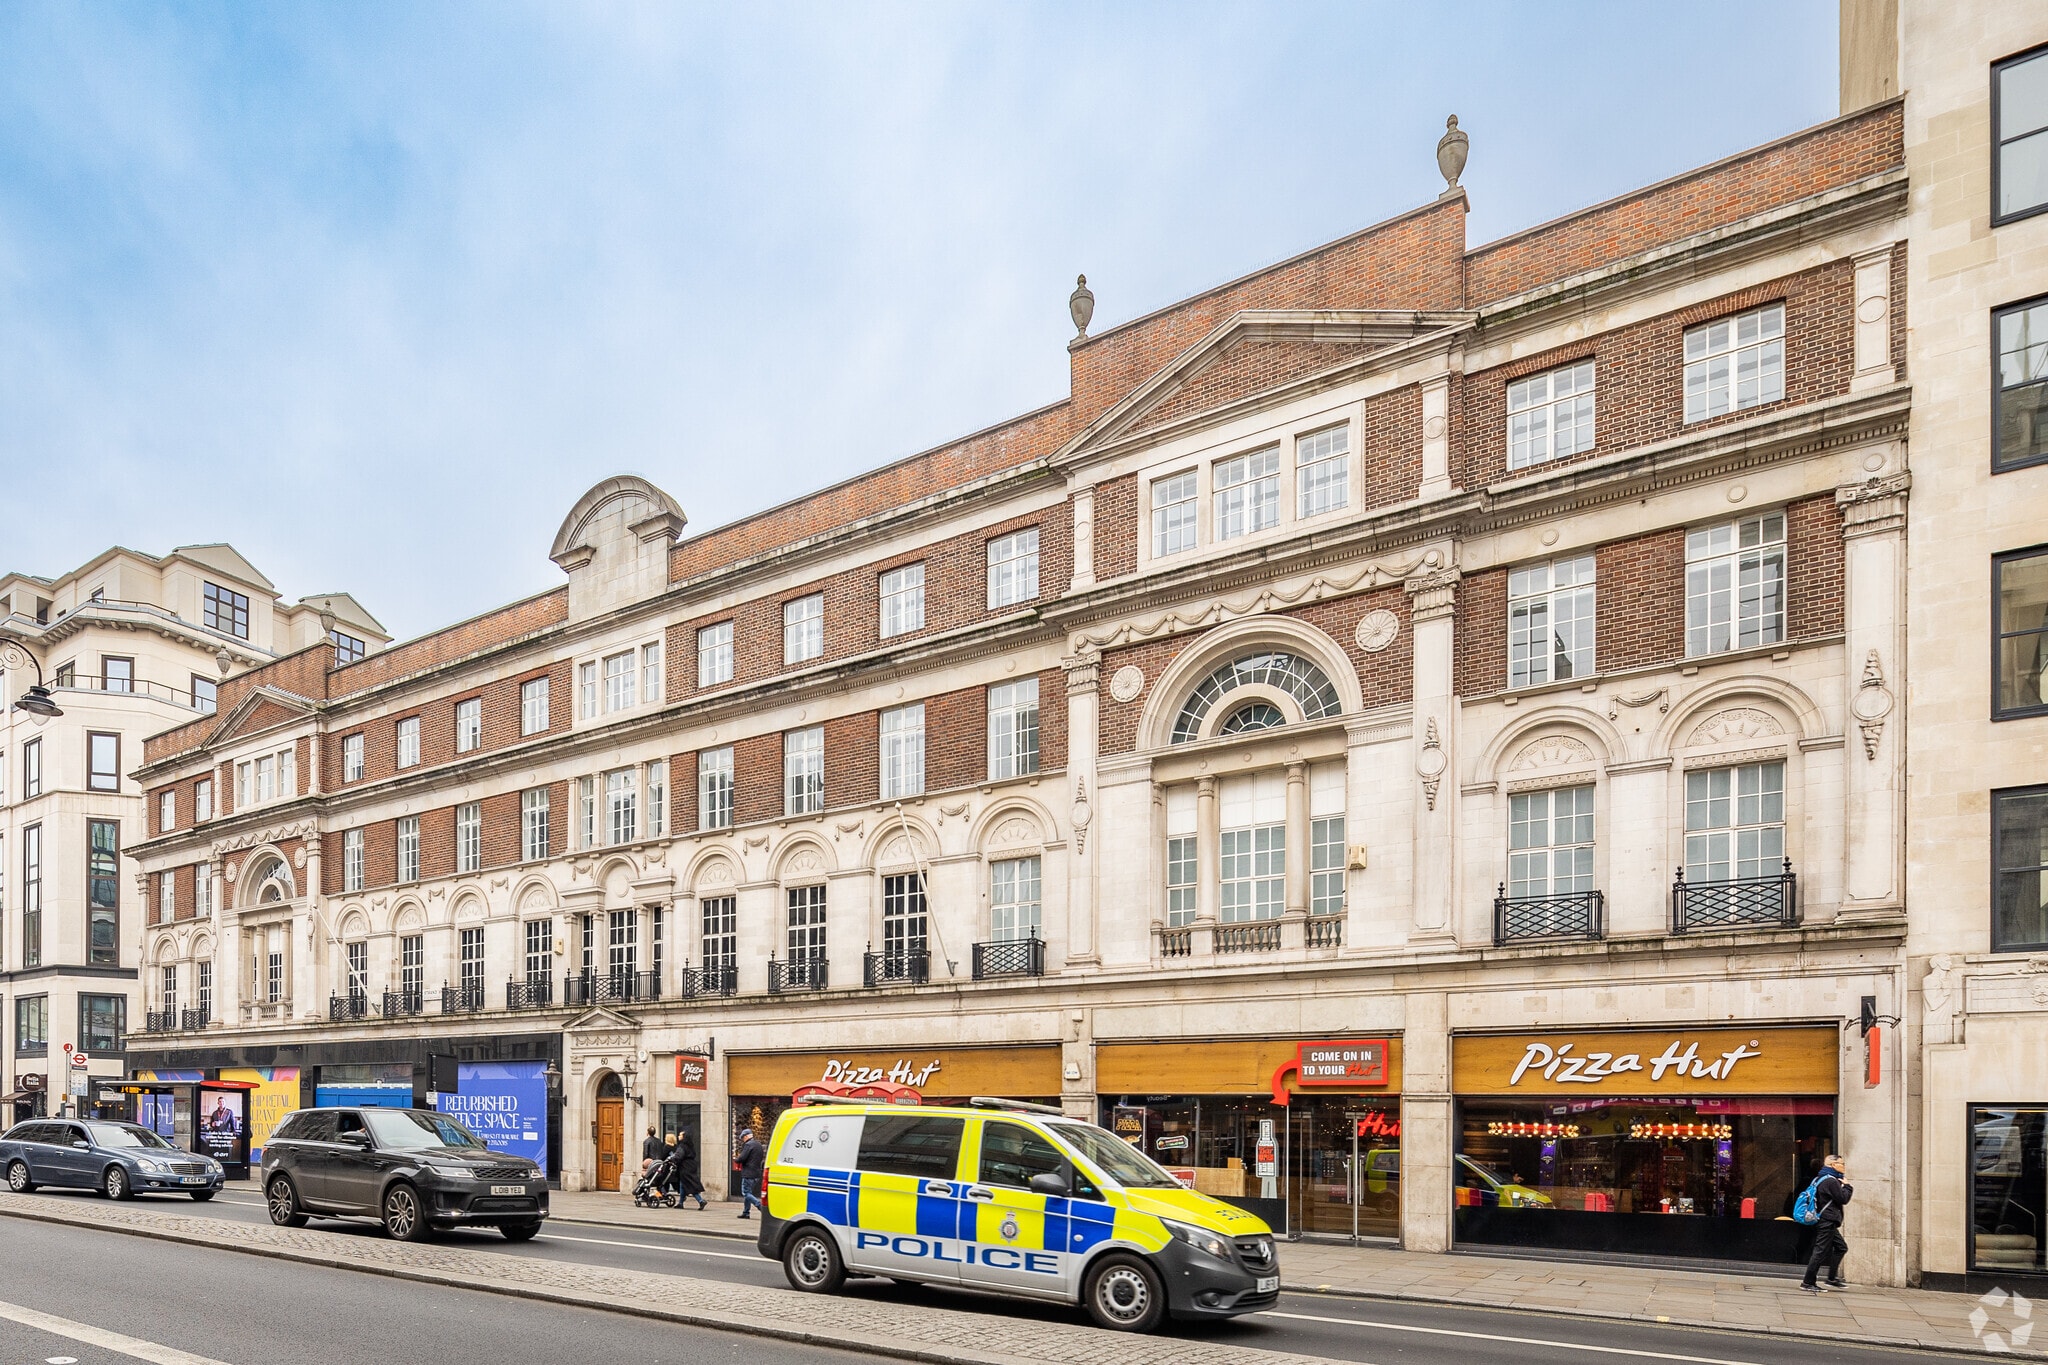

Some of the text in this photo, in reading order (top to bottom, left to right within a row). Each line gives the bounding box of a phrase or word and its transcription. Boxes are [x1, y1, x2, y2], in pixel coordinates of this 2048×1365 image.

[601, 1057, 608, 1065] 60
[1311, 1051, 1372, 1062] COME ON IN
[1510, 1040, 1761, 1085] Pizza Hut
[682, 1063, 704, 1075] Pizza
[822, 1059, 941, 1088] Pizza Hut
[1303, 1062, 1381, 1077] TO YOUR Hut
[685, 1074, 703, 1082] Hut
[445, 1095, 518, 1112] REFURBISHED
[484, 1113, 520, 1129] SPACE
[795, 1139, 813, 1149] SRU
[857, 1231, 1059, 1275] POLICE
